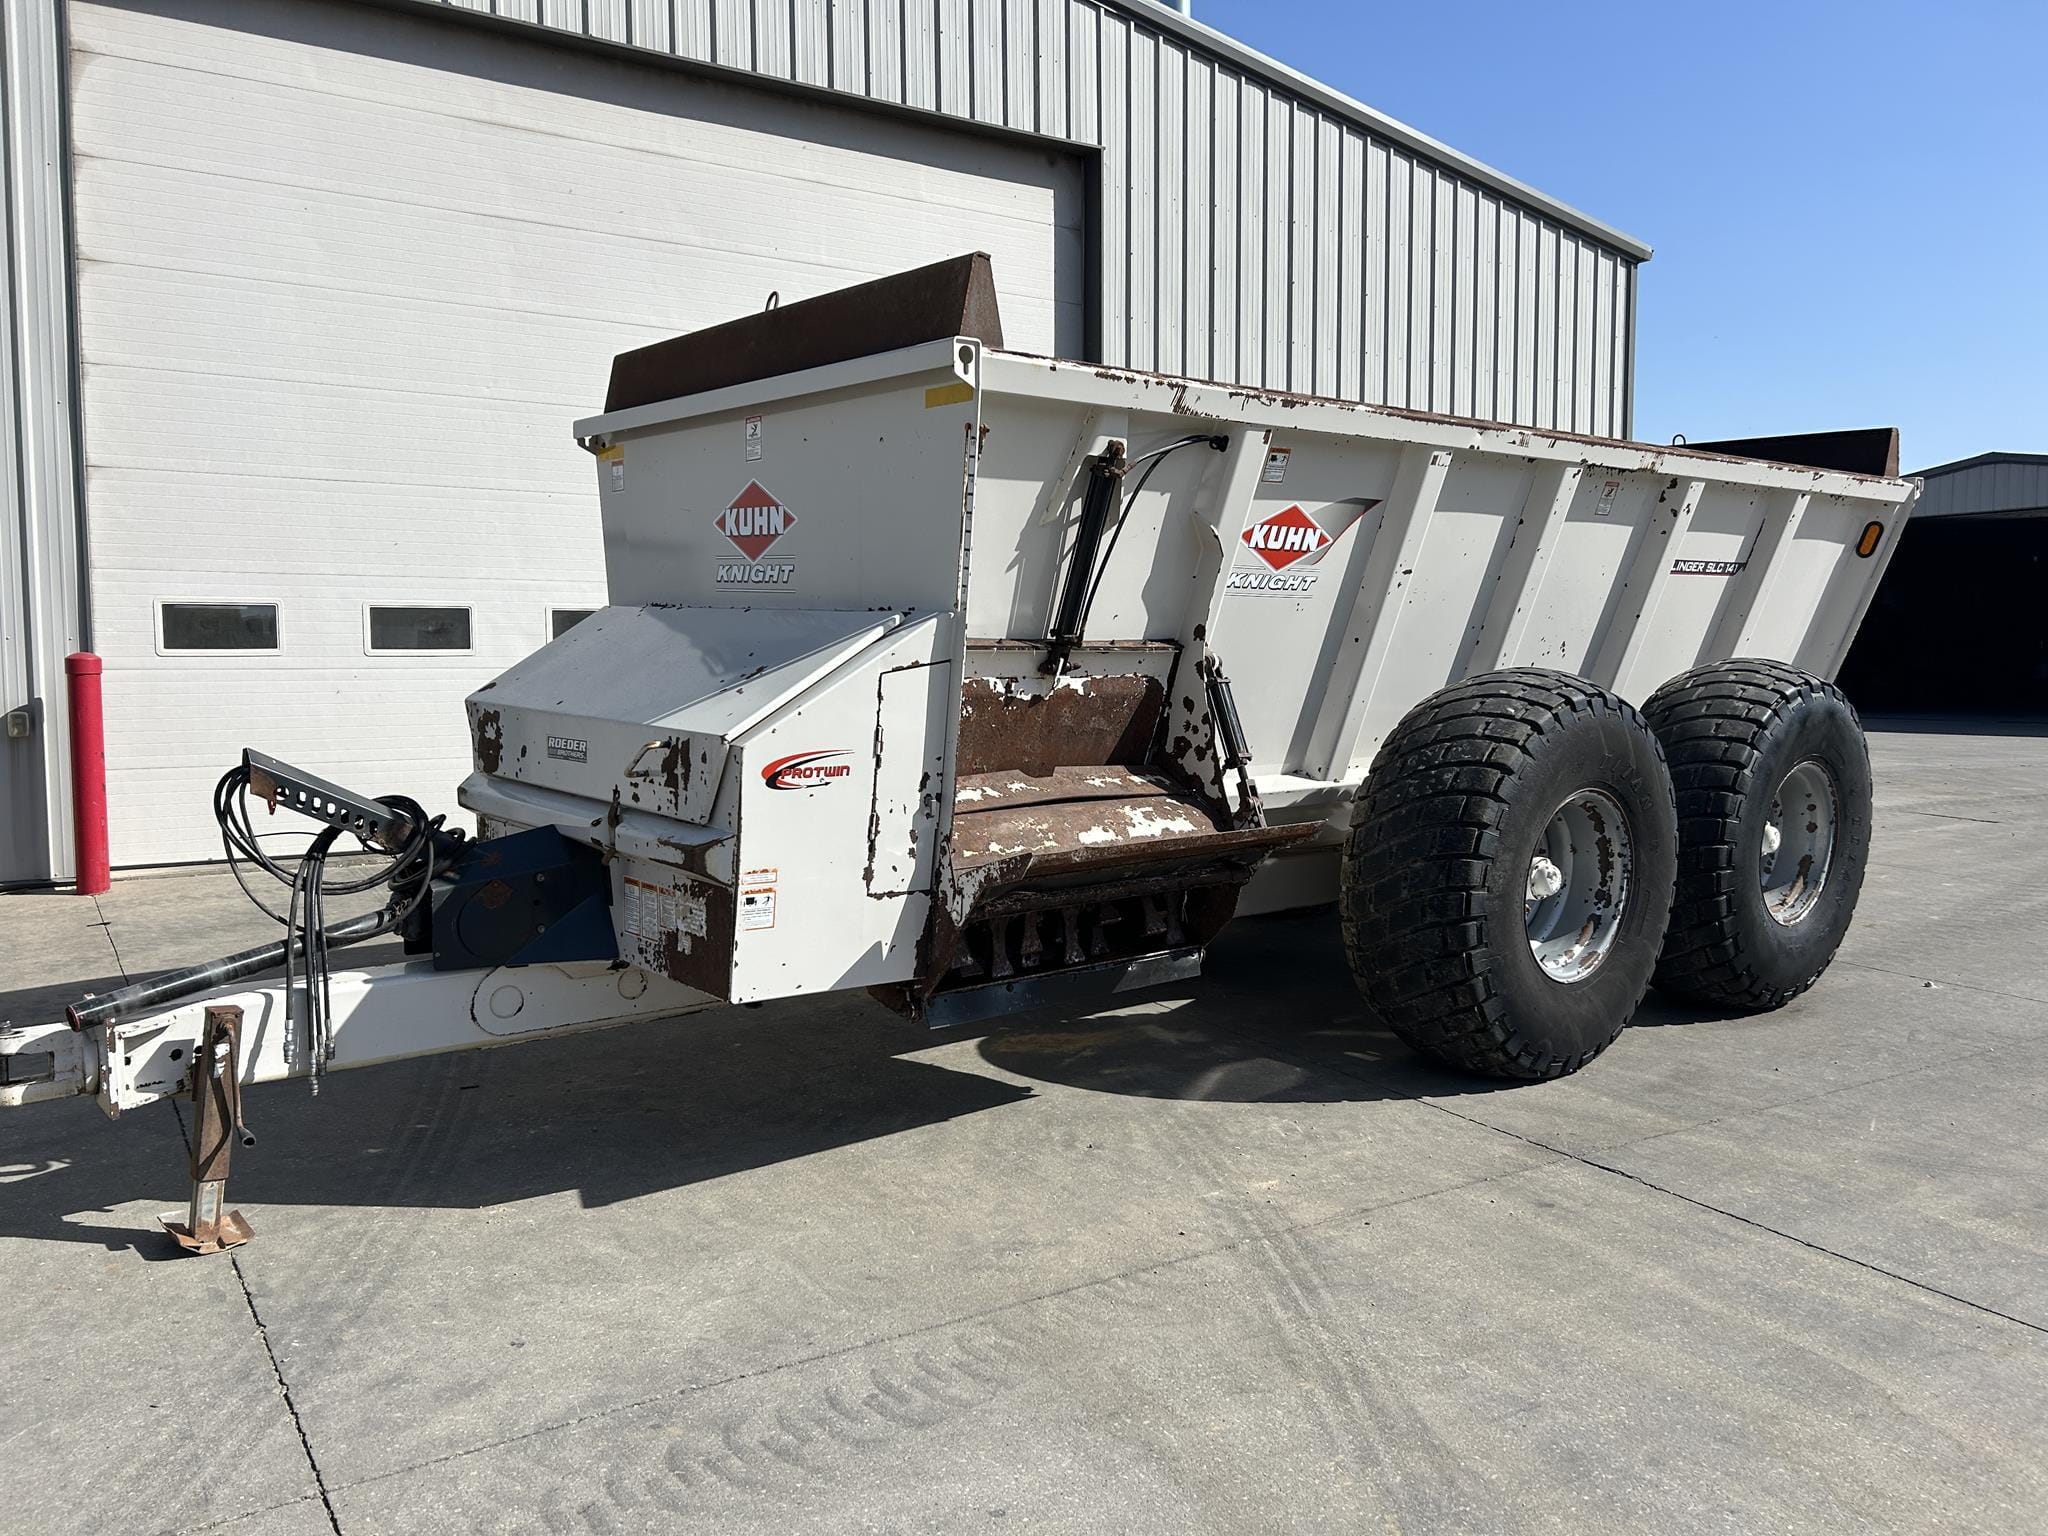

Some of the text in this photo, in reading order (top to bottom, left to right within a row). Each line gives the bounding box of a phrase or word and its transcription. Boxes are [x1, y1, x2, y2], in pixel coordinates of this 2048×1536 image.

[725, 505, 785, 537] KUHN
[1248, 524, 1322, 552] KUHN
[716, 564, 795, 584] KNIGHT
[1706, 562, 1724, 573] SLC
[1227, 572, 1318, 591] KNIGHT
[548, 737, 586, 752] ROEDER
[780, 765, 850, 780] PROTWIN
